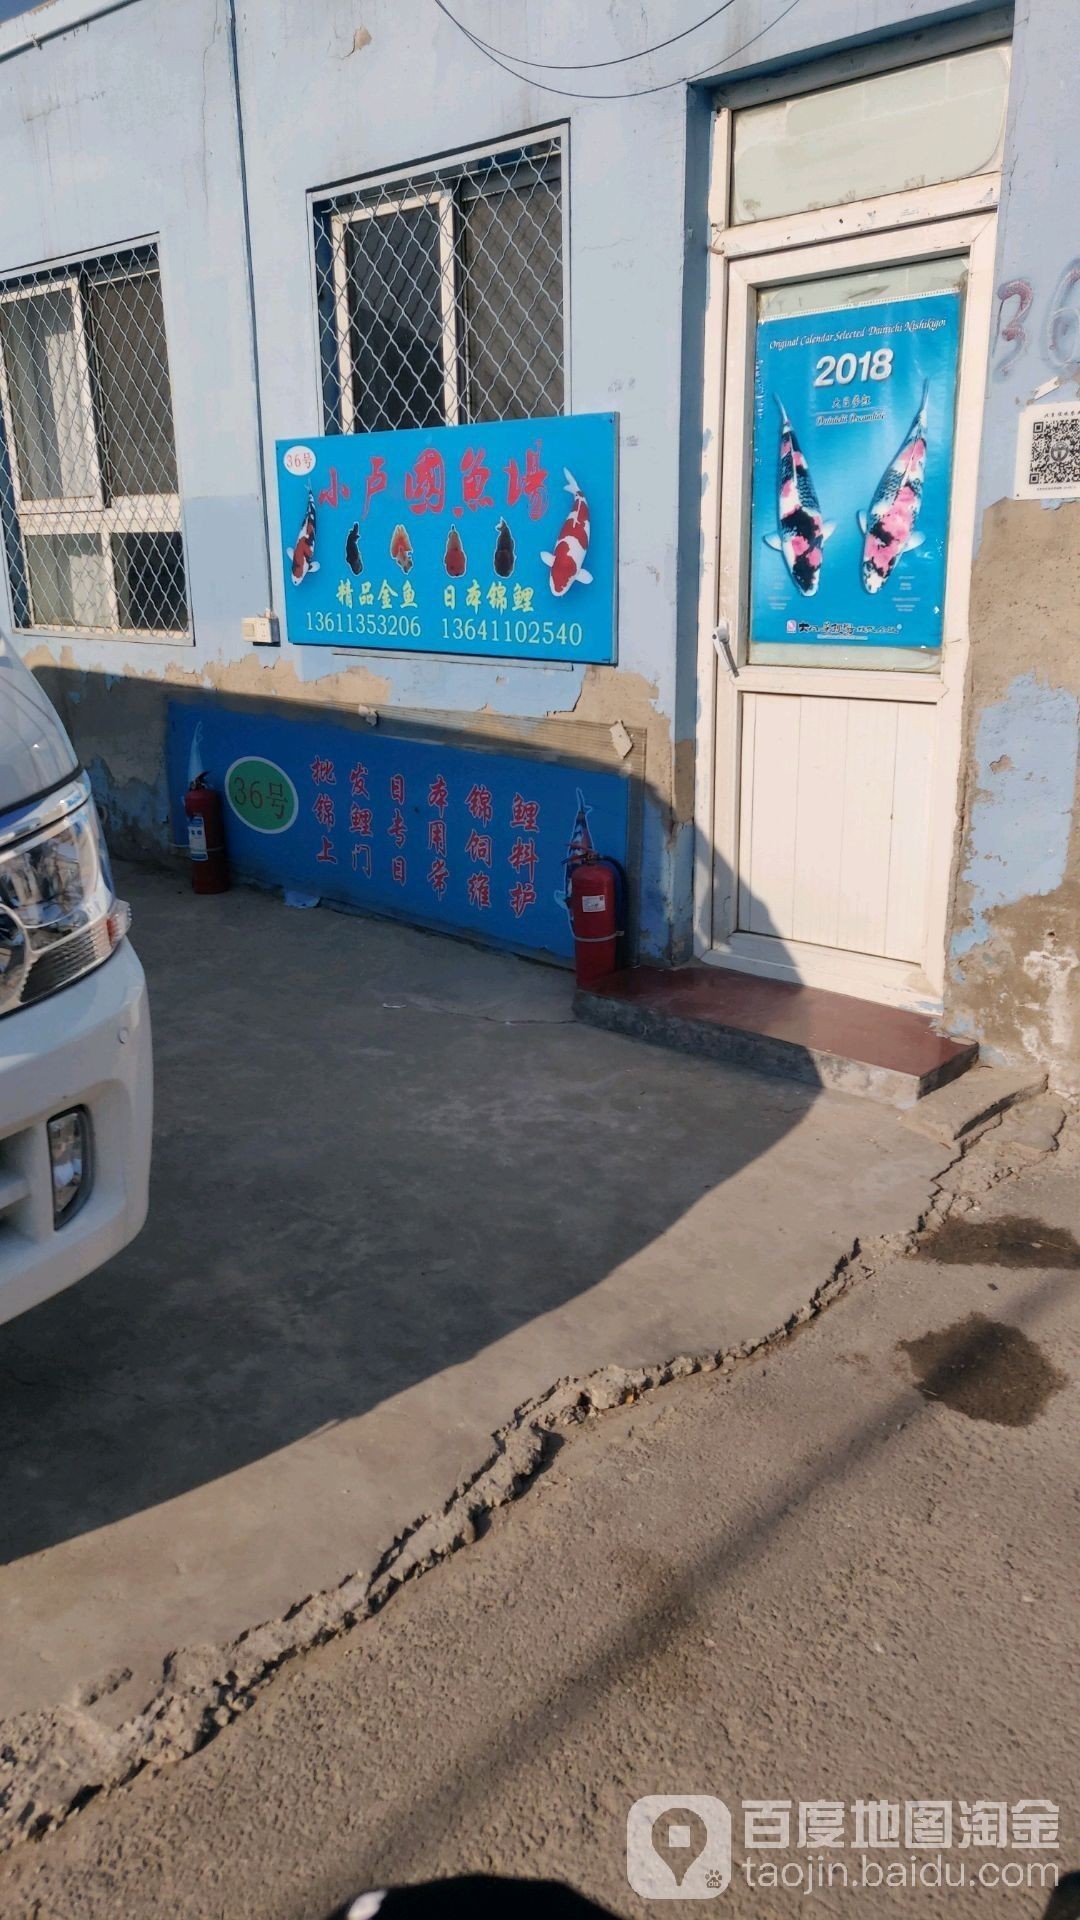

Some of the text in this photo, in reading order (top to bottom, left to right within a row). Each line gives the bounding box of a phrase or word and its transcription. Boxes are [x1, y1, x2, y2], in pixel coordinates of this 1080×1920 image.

[800, 333, 834, 346] Calendar
[834, 328, 865, 342] Selected
[813, 348, 895, 388] 2018
[286, 453, 313, 469] 36号
[443, 579, 534, 615] 日本锦鲤
[306, 611, 583, 647] 13611353206 13641102540
[233, 776, 289, 820] 36号
